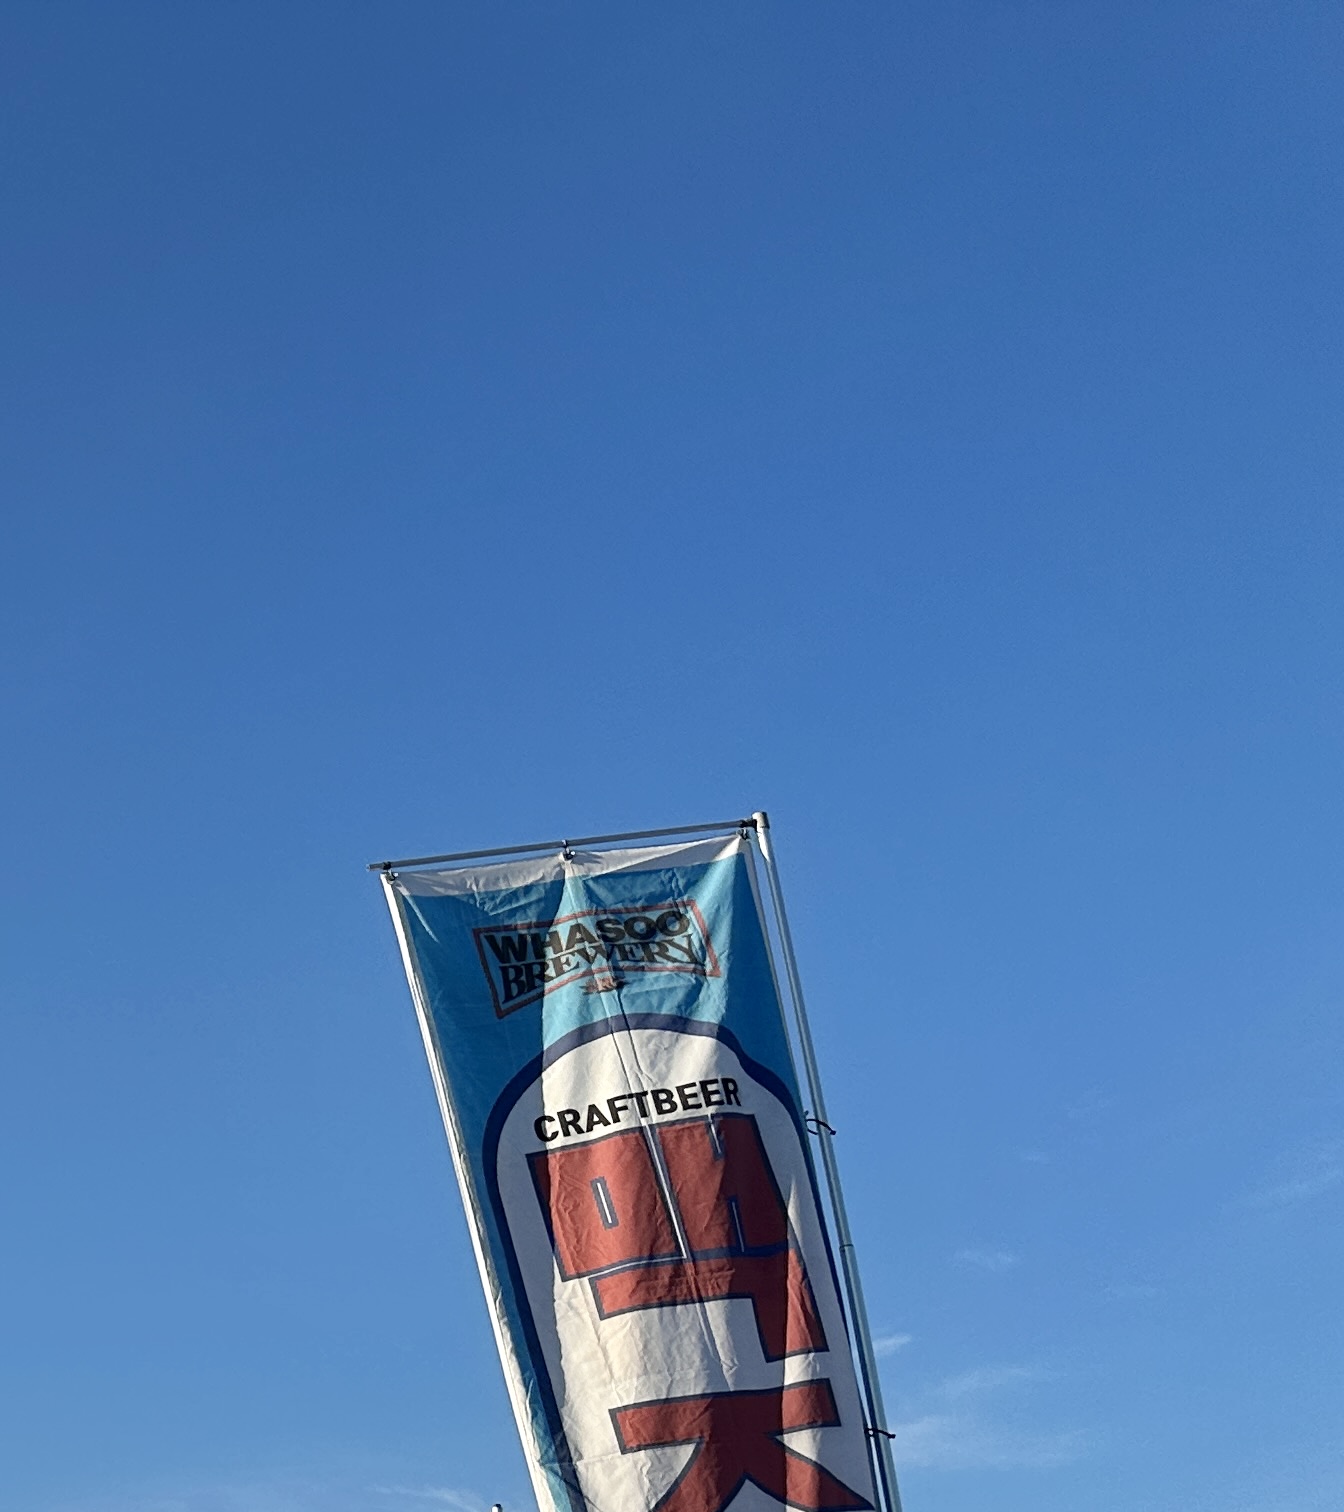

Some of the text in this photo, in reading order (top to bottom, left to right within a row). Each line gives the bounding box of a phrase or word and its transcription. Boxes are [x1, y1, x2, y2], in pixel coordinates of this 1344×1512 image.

[485, 908, 691, 965] WHASOO
[500, 933, 706, 1003] BREWERY
[534, 1077, 742, 1143] CRAFTBEER
